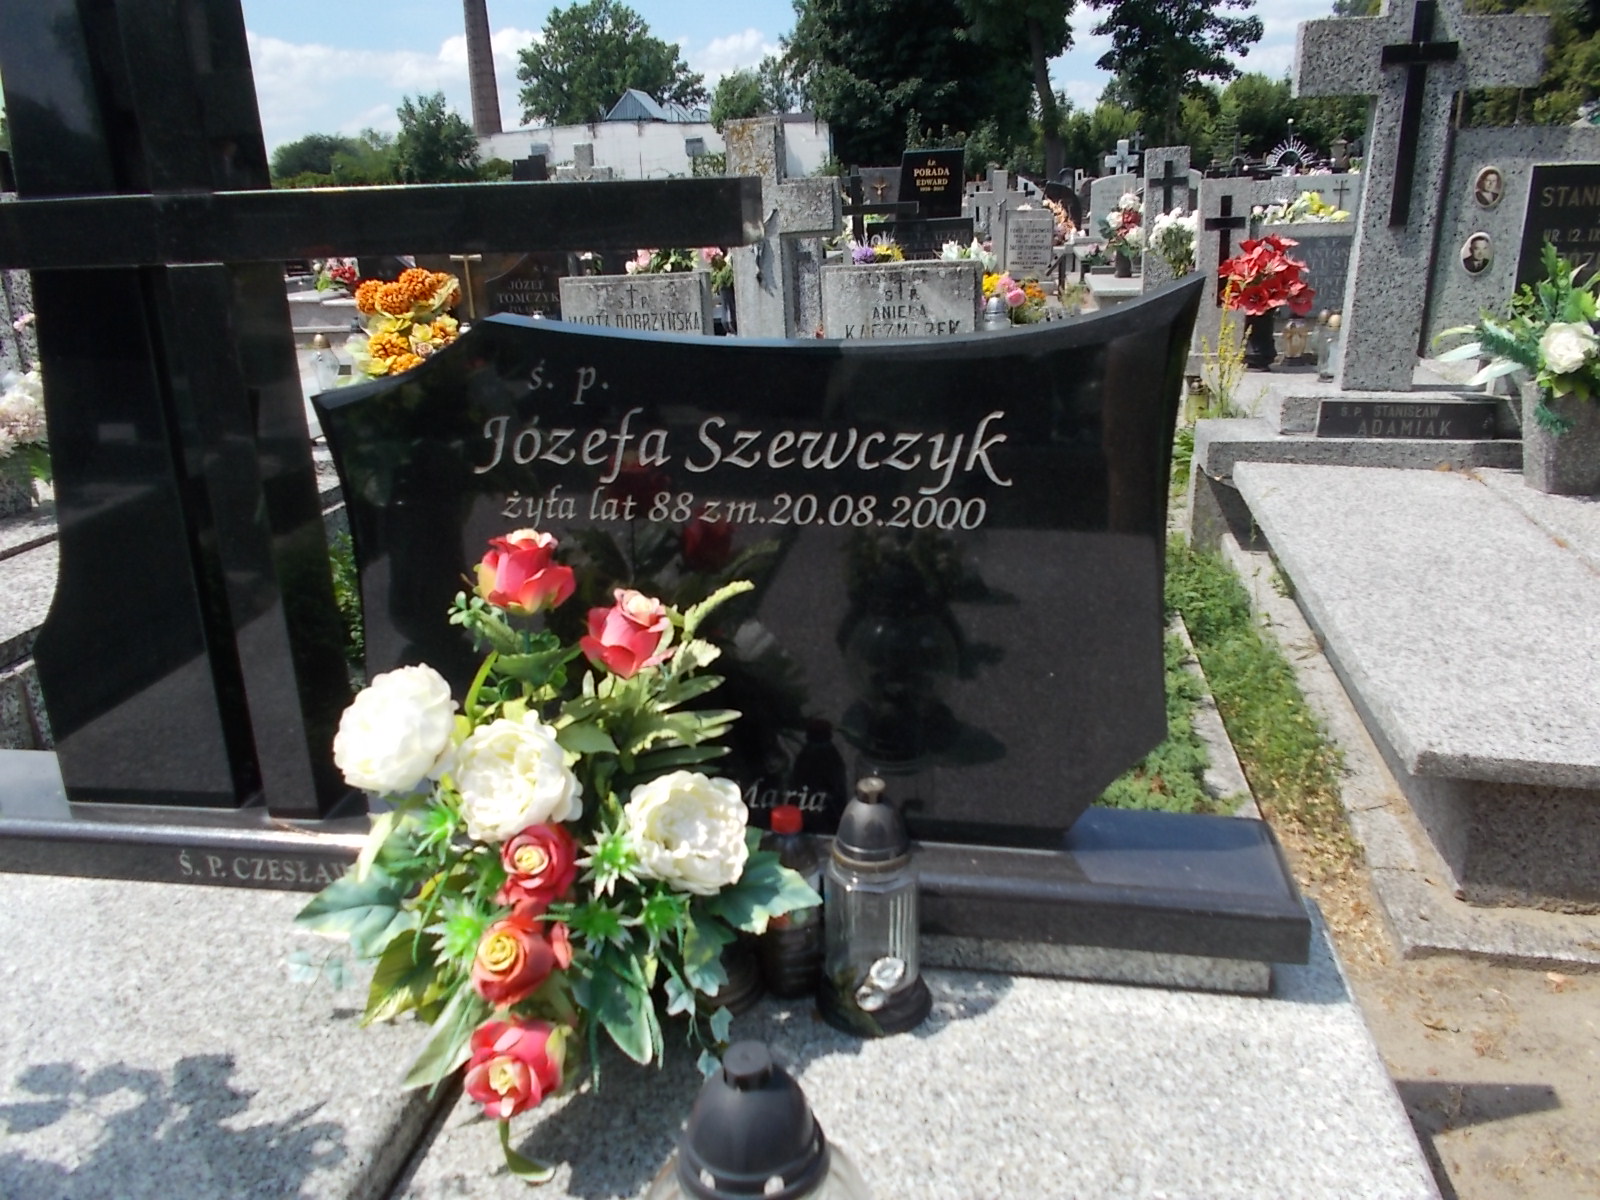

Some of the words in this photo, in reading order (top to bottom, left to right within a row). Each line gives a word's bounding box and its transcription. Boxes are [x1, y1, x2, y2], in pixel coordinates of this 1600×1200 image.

[913, 168, 950, 177] PORADA
[916, 178, 948, 187] EDWARD
[508, 278, 544, 290] JÓZEF
[497, 292, 560, 304] TOMCZYK
[573, 365, 609, 406] p.
[1374, 405, 1441, 418] STANISŁAW
[1357, 419, 1452, 437] ADAMIAK
[474, 407, 672, 484] Józefa
[684, 410, 1013, 495] Szewczyk
[501, 484, 577, 529] żyła
[589, 486, 638, 521] lat
[648, 491, 694, 523] 88
[179, 849, 201, 876] Ś.
[206, 855, 227, 879] P.
